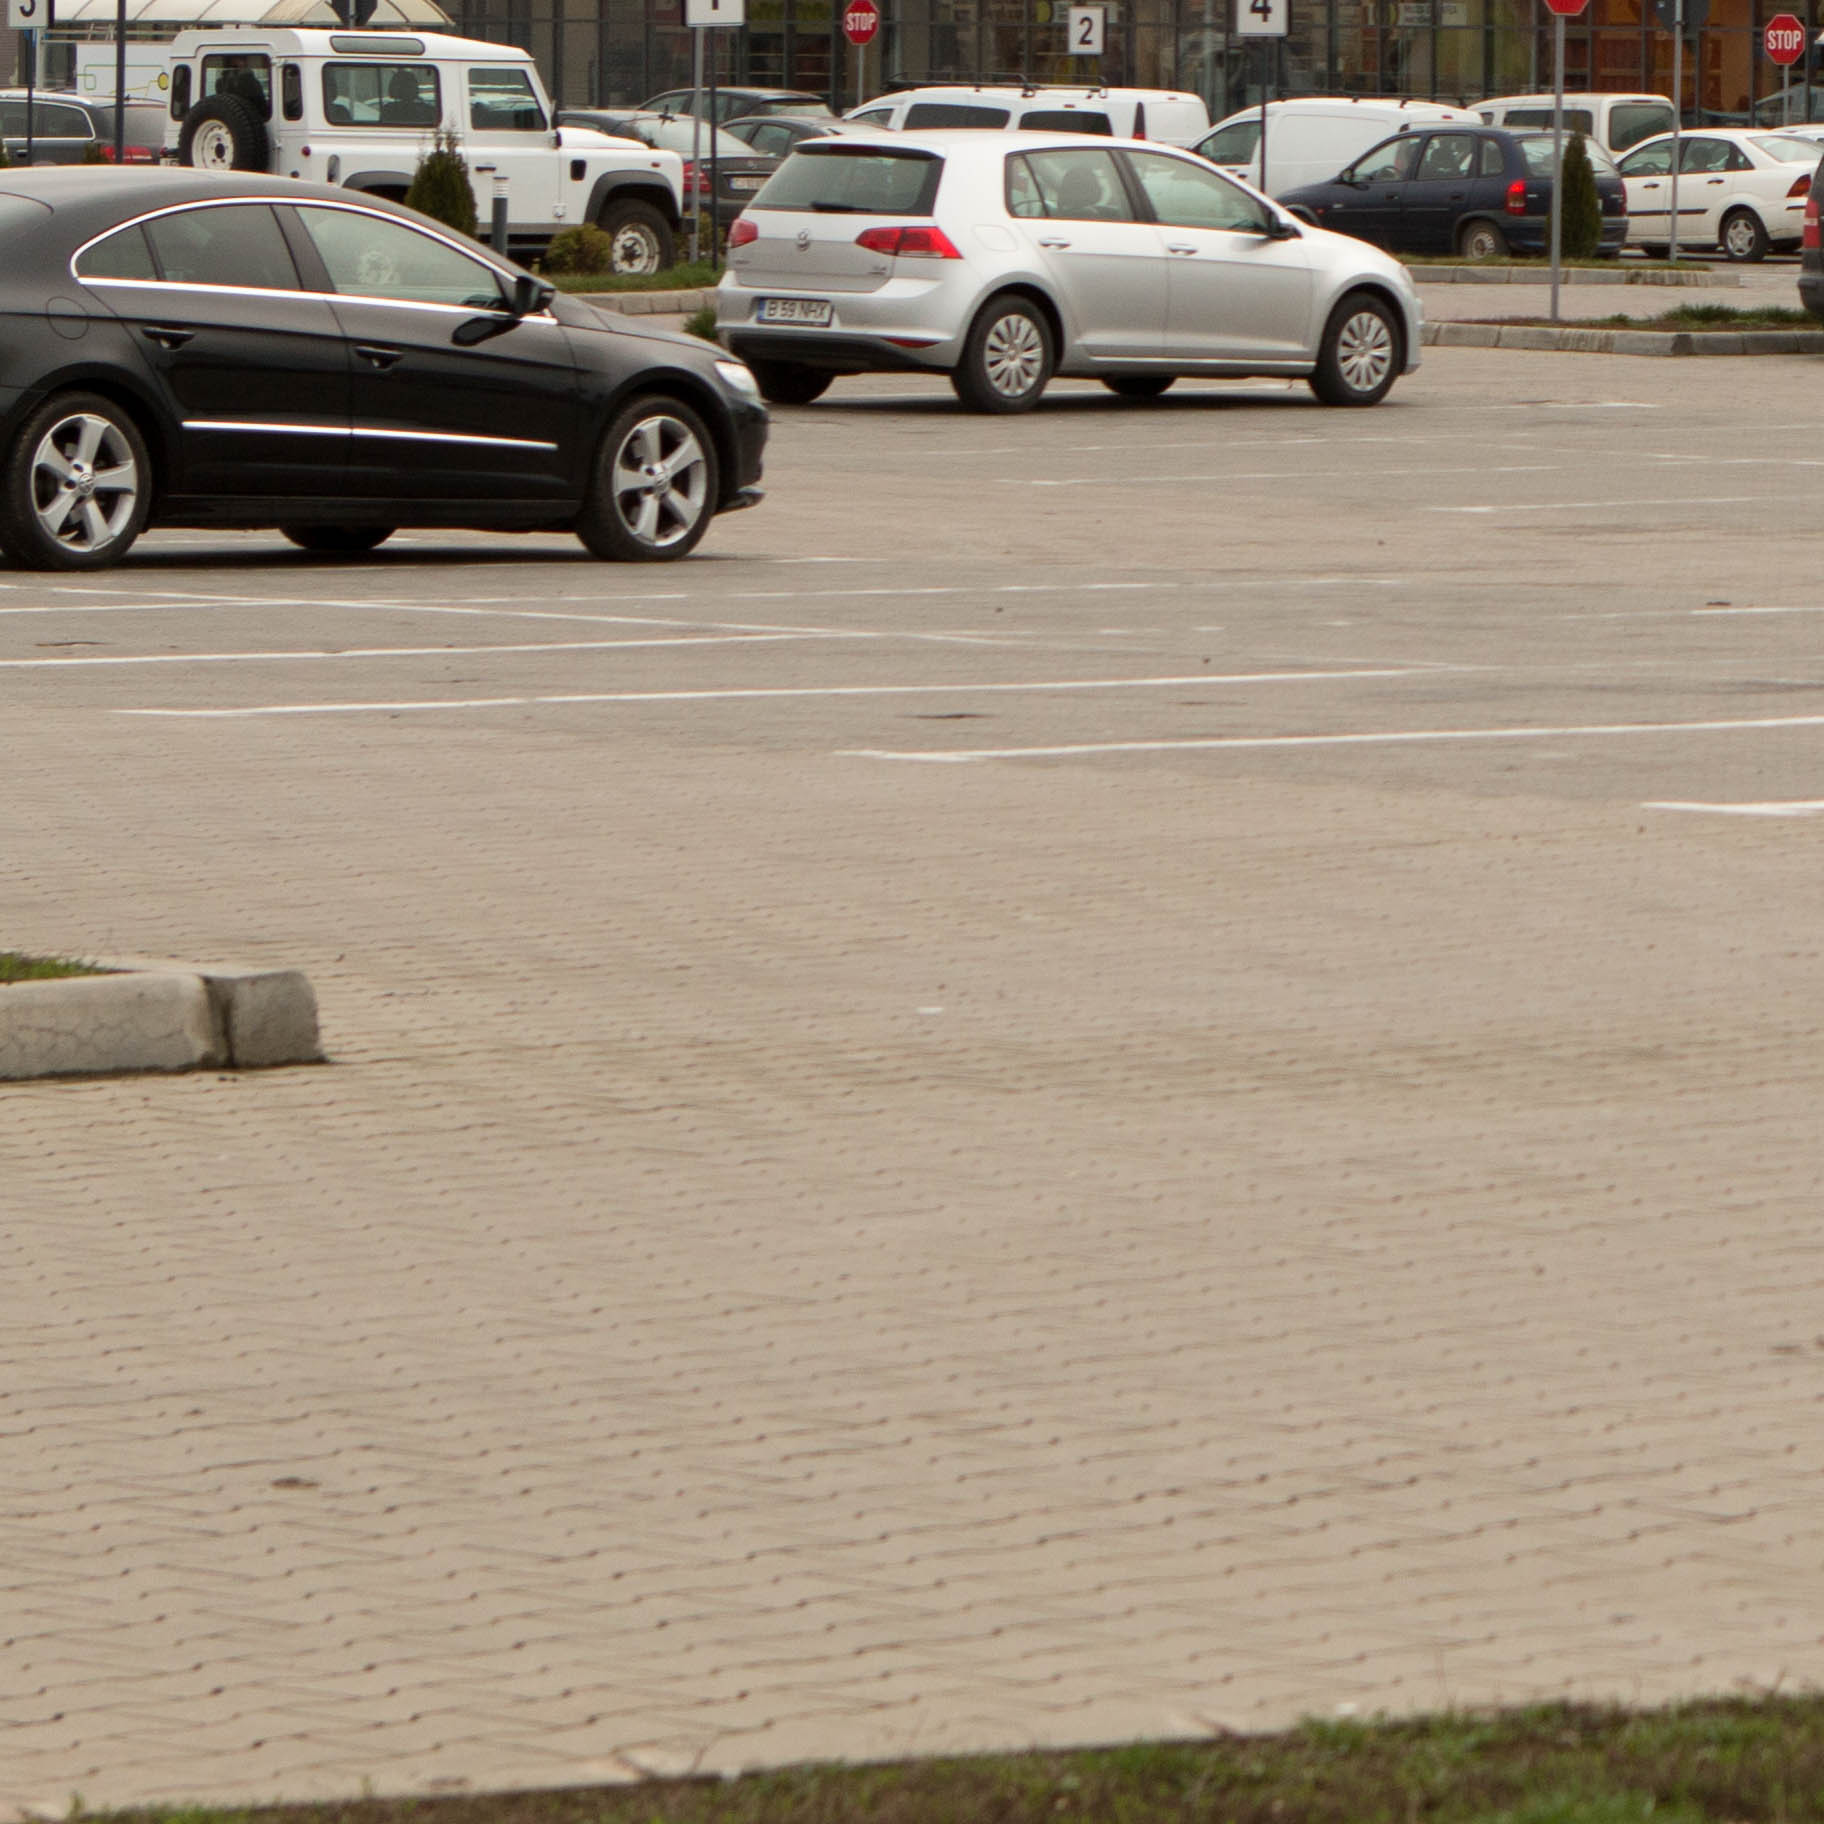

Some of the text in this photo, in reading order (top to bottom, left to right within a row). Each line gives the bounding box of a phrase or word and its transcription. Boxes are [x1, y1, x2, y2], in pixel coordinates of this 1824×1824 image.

[847, 13, 876, 32] STOP
[1079, 16, 1094, 45] 2
[1767, 29, 1802, 50] STOP
